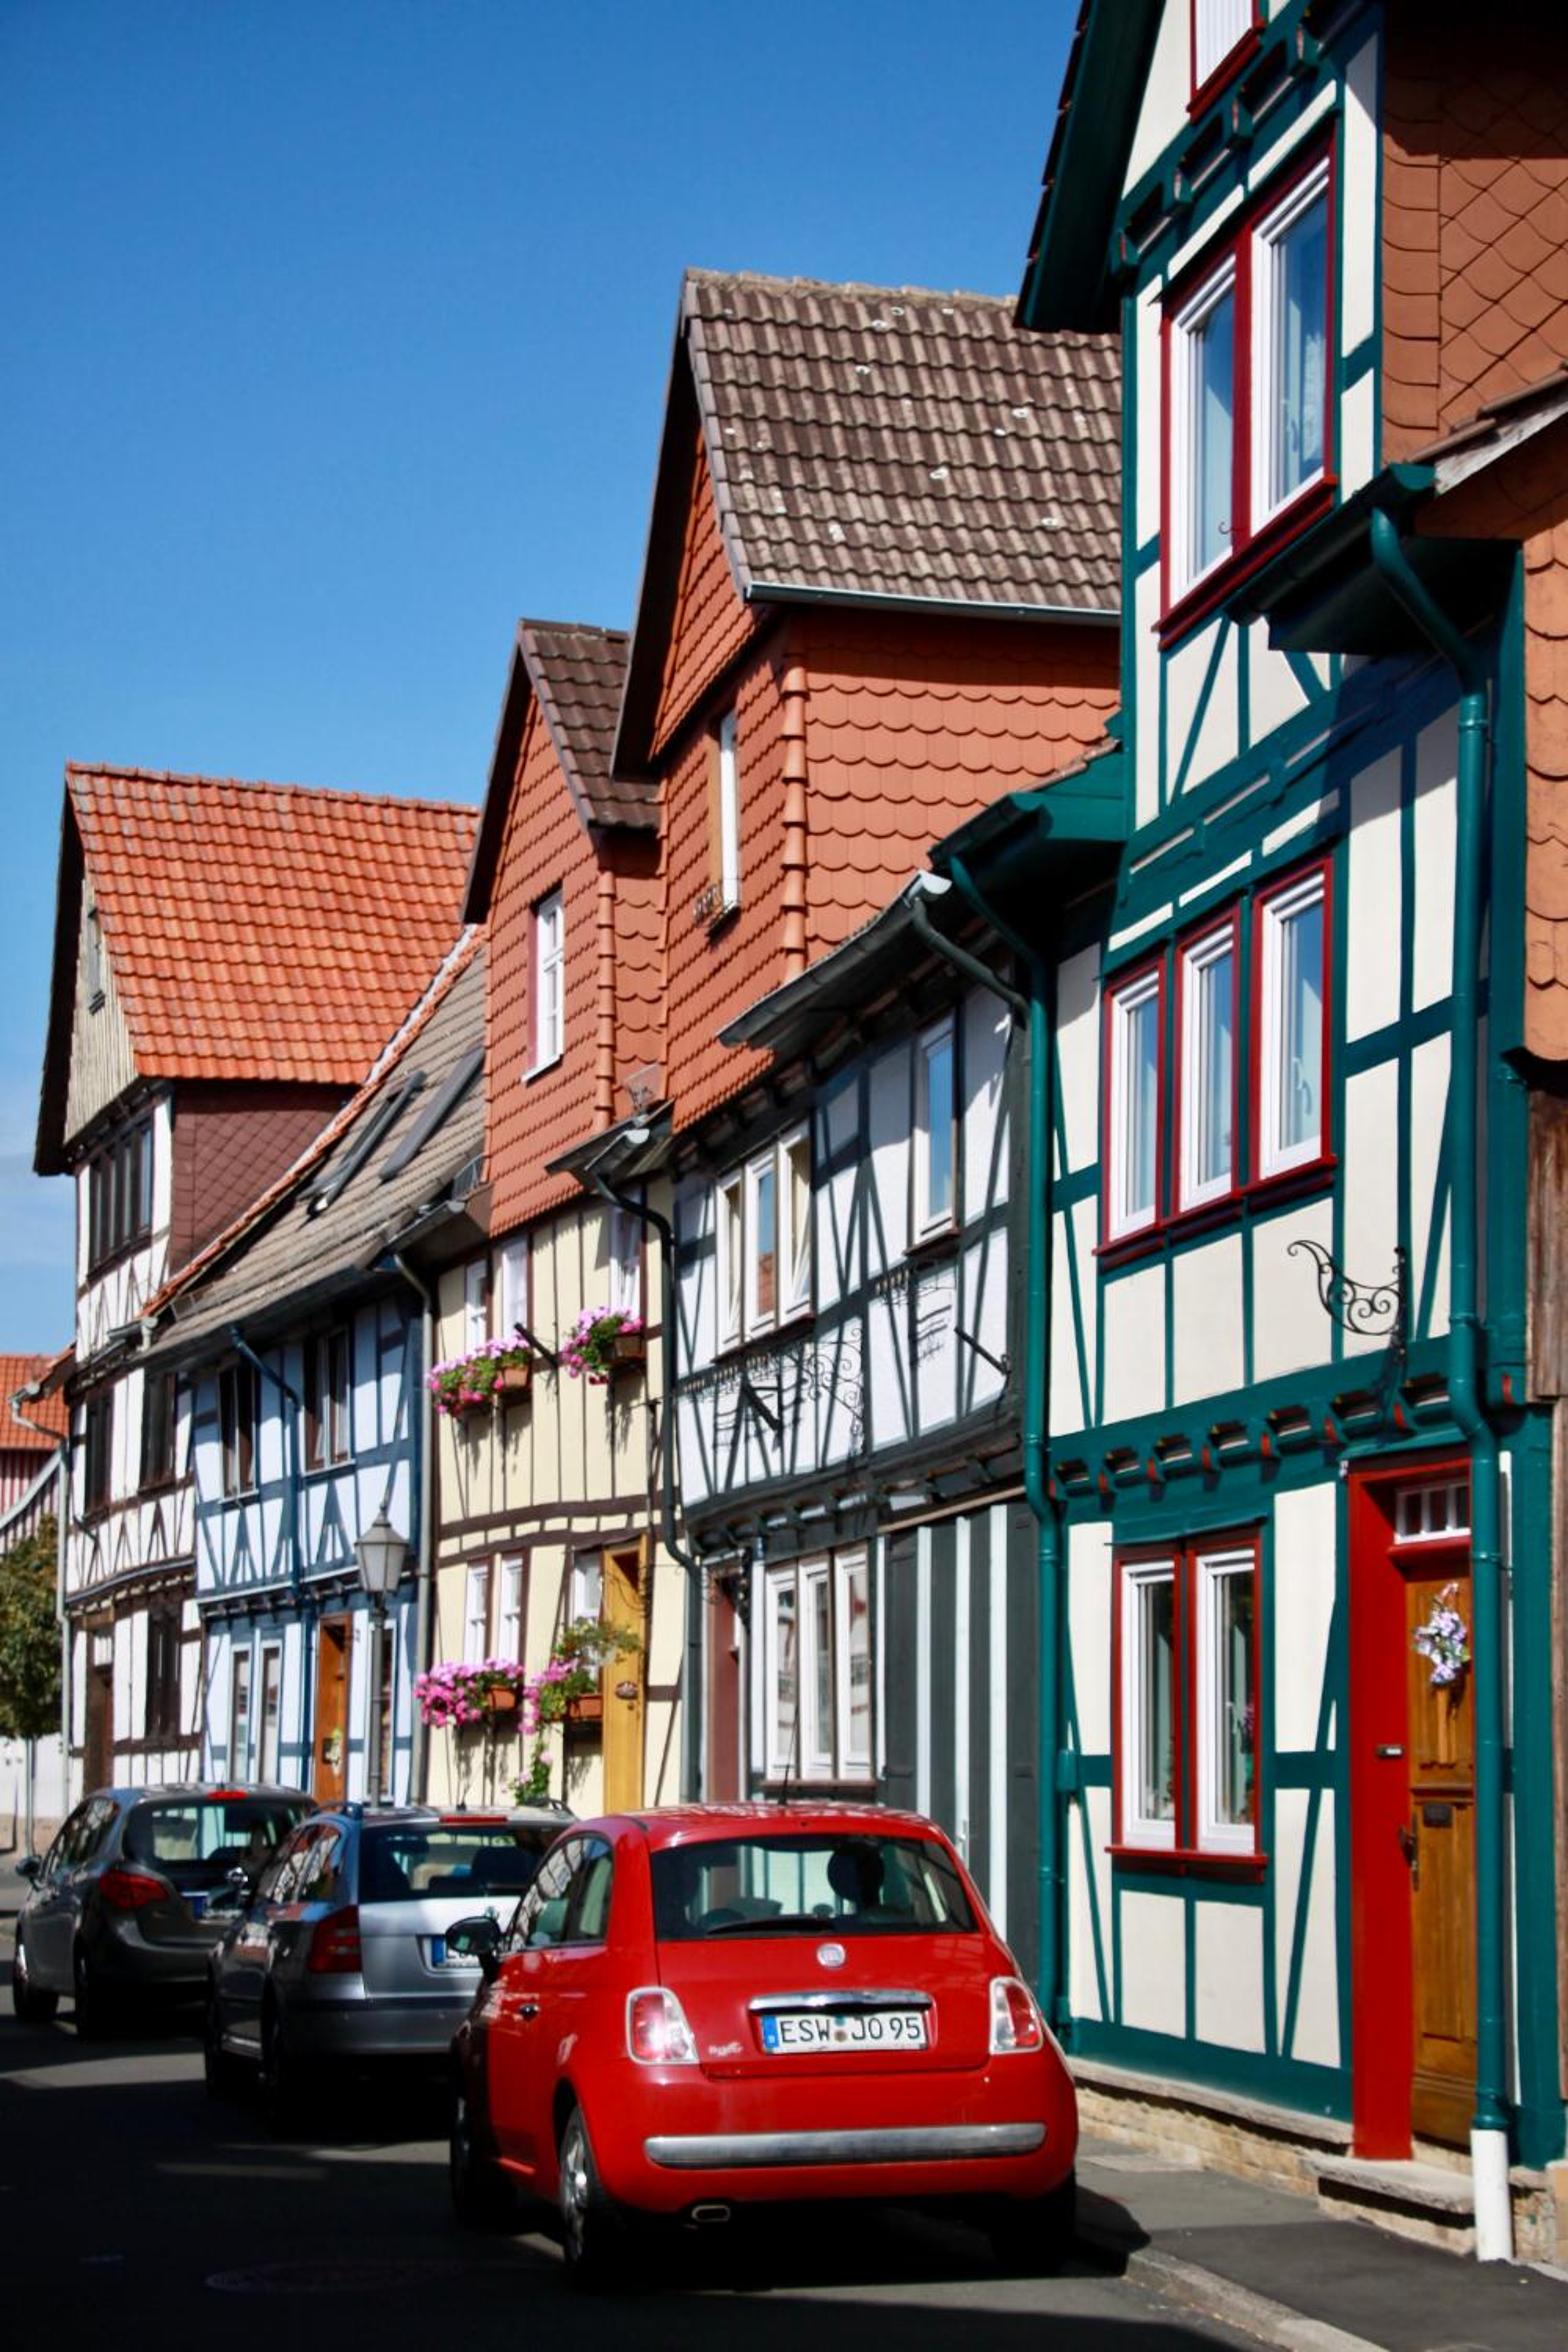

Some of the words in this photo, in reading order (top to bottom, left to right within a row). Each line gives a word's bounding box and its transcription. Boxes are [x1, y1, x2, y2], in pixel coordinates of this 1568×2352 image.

[779, 2019, 831, 2043] ESW
[852, 2016, 883, 2041] JO
[889, 2016, 921, 2040] 95
